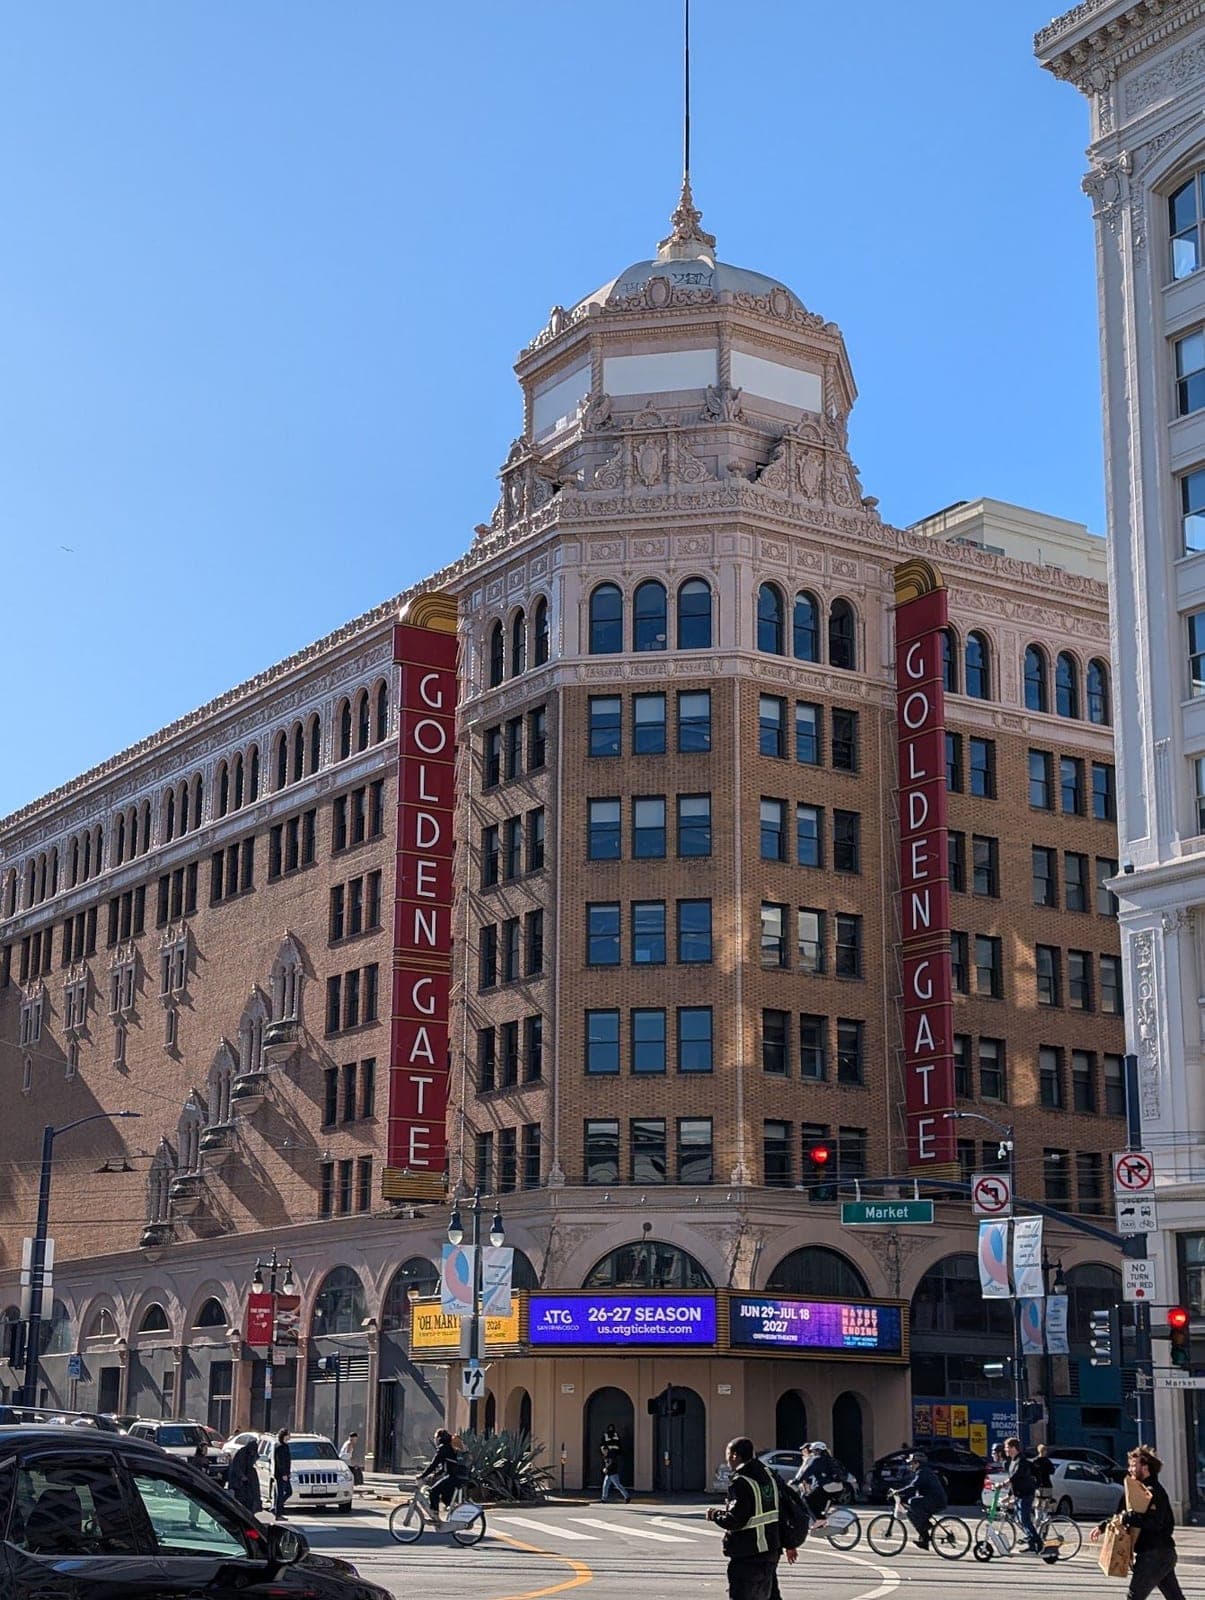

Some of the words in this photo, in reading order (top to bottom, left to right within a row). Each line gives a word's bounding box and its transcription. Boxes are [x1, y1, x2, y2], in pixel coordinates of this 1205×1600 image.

[903, 641, 931, 931] GOLDEN
[412, 672, 446, 947] GOLDEN
[913, 960, 936, 1160] GATE
[408, 976, 437, 1167] GATE
[865, 1206, 909, 1219] Market
[1131, 1264, 1146, 1272] NO
[1126, 1281, 1137, 1289] ON
[1139, 1281, 1153, 1289] RED
[543, 1310, 572, 1324] ATG
[588, 1307, 632, 1322] 26-27
[634, 1307, 701, 1322] SEASON
[740, 1304, 760, 1318] JUN
[799, 1308, 810, 1320] 18
[762, 1320, 788, 1333] 2027
[842, 1317, 877, 1328] HAPPY
[597, 1324, 693, 1336] us.atgtickets.com
[842, 1326, 878, 1337] ENDING
